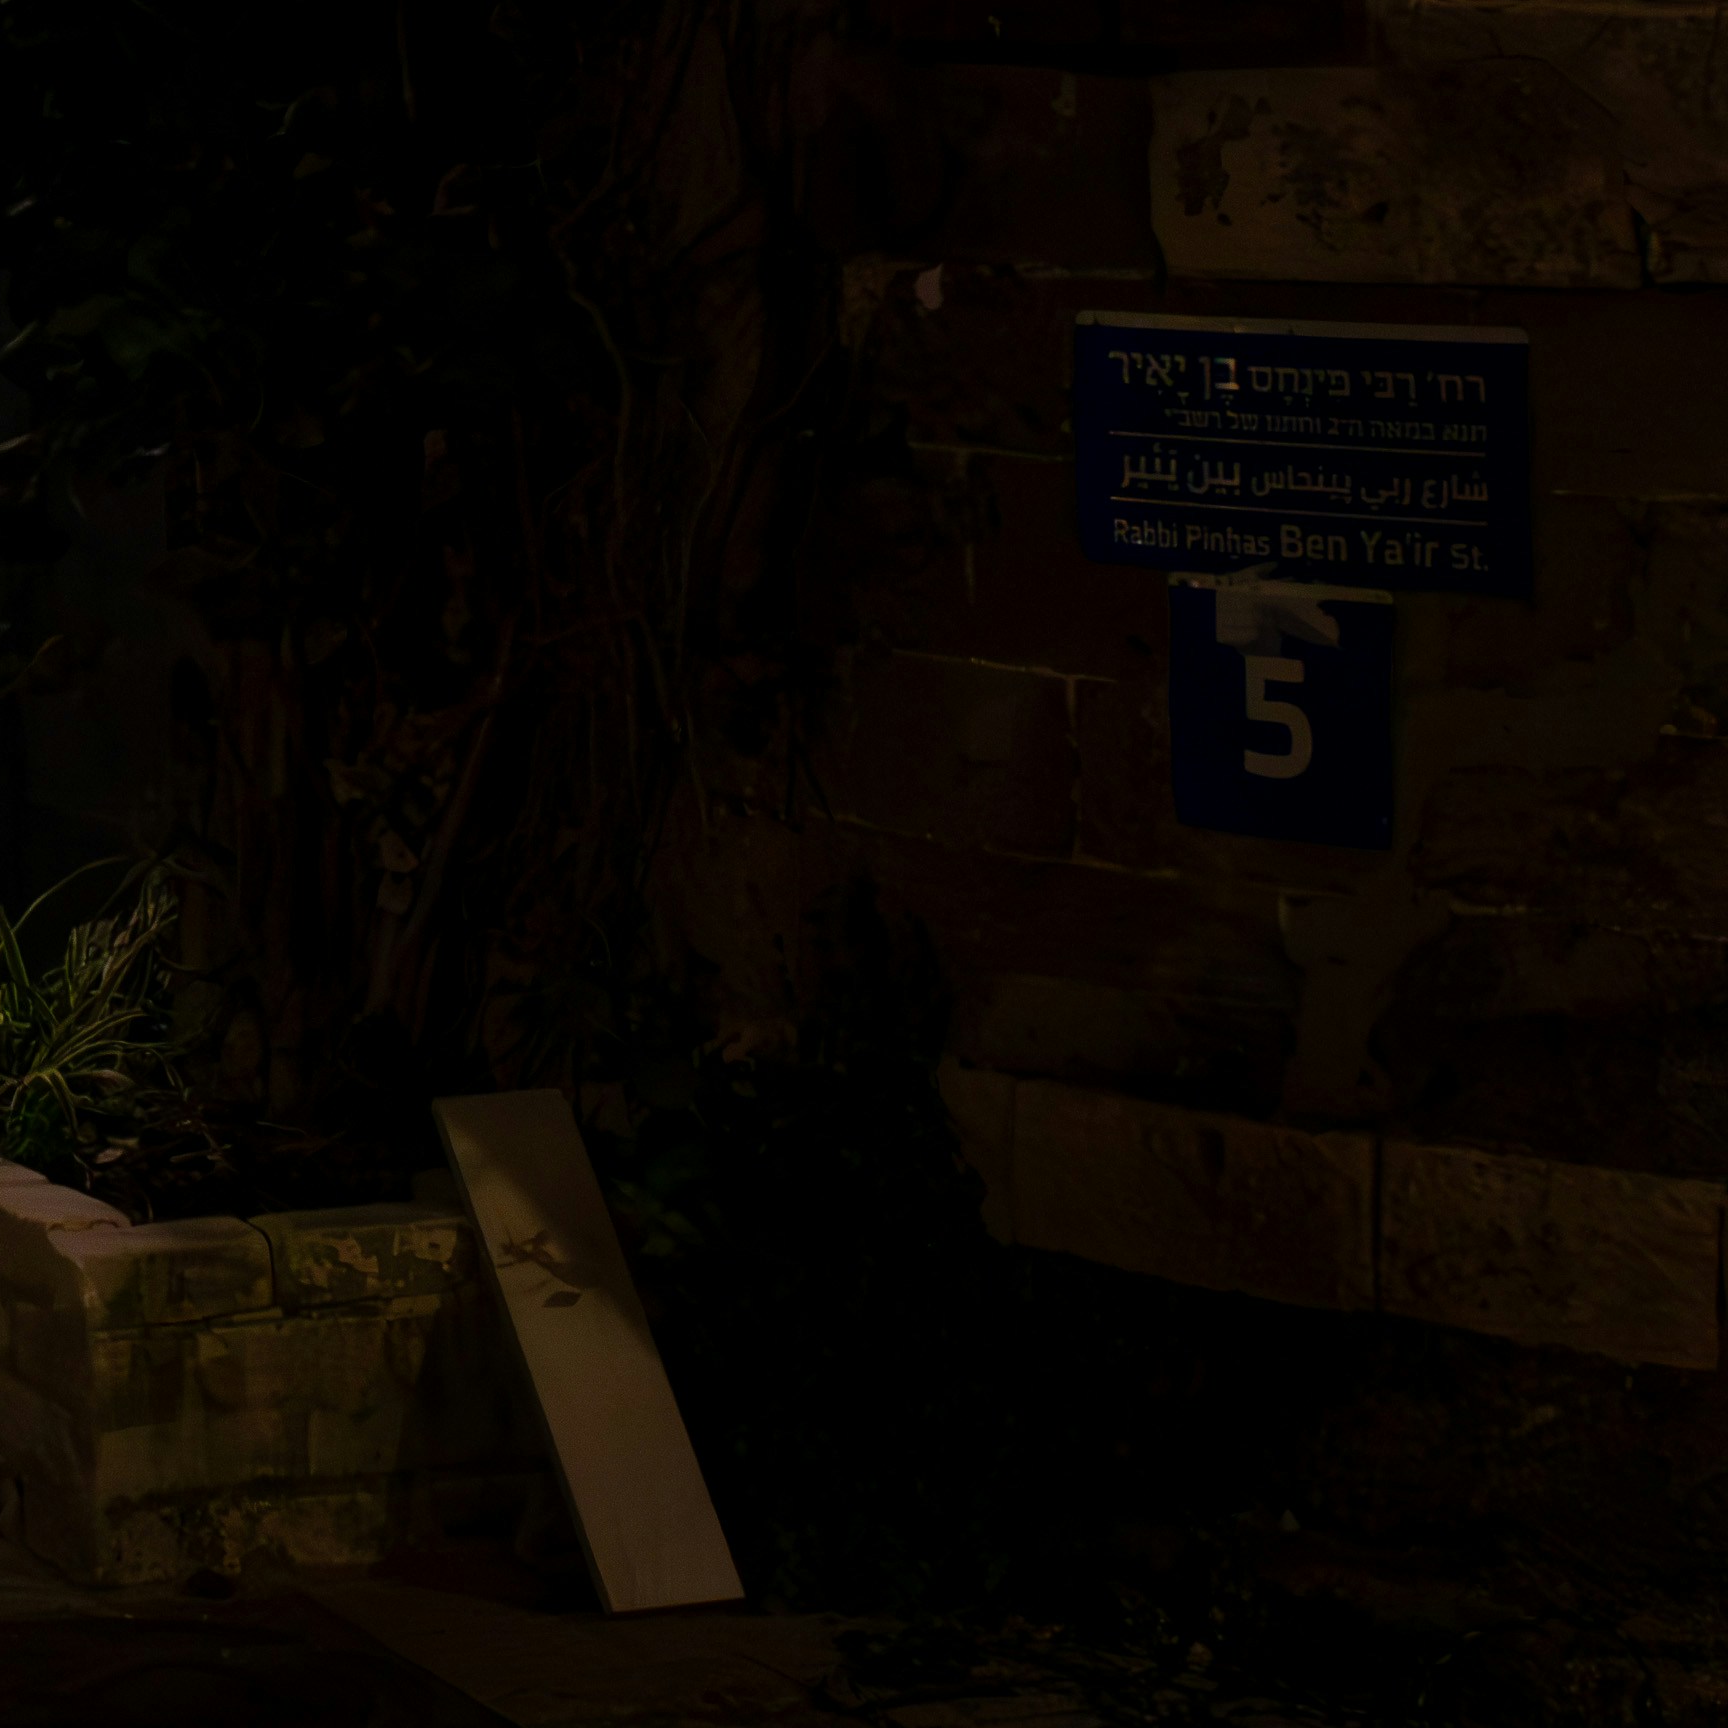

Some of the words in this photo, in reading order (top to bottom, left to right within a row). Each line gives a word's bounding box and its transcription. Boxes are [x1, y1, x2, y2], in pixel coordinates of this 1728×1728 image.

[1426, 371, 1488, 404] רח'
[1226, 407, 1260, 432] של
[1186, 450, 1242, 496] بين
[1359, 476, 1413, 510] ربي
[1419, 468, 1490, 511] شارع
[1111, 515, 1179, 550] Rabbi
[1278, 522, 1350, 563] Ben
[1359, 528, 1441, 570] Ya'ir
[1449, 541, 1490, 572] St.
[1243, 655, 1314, 780] 5
